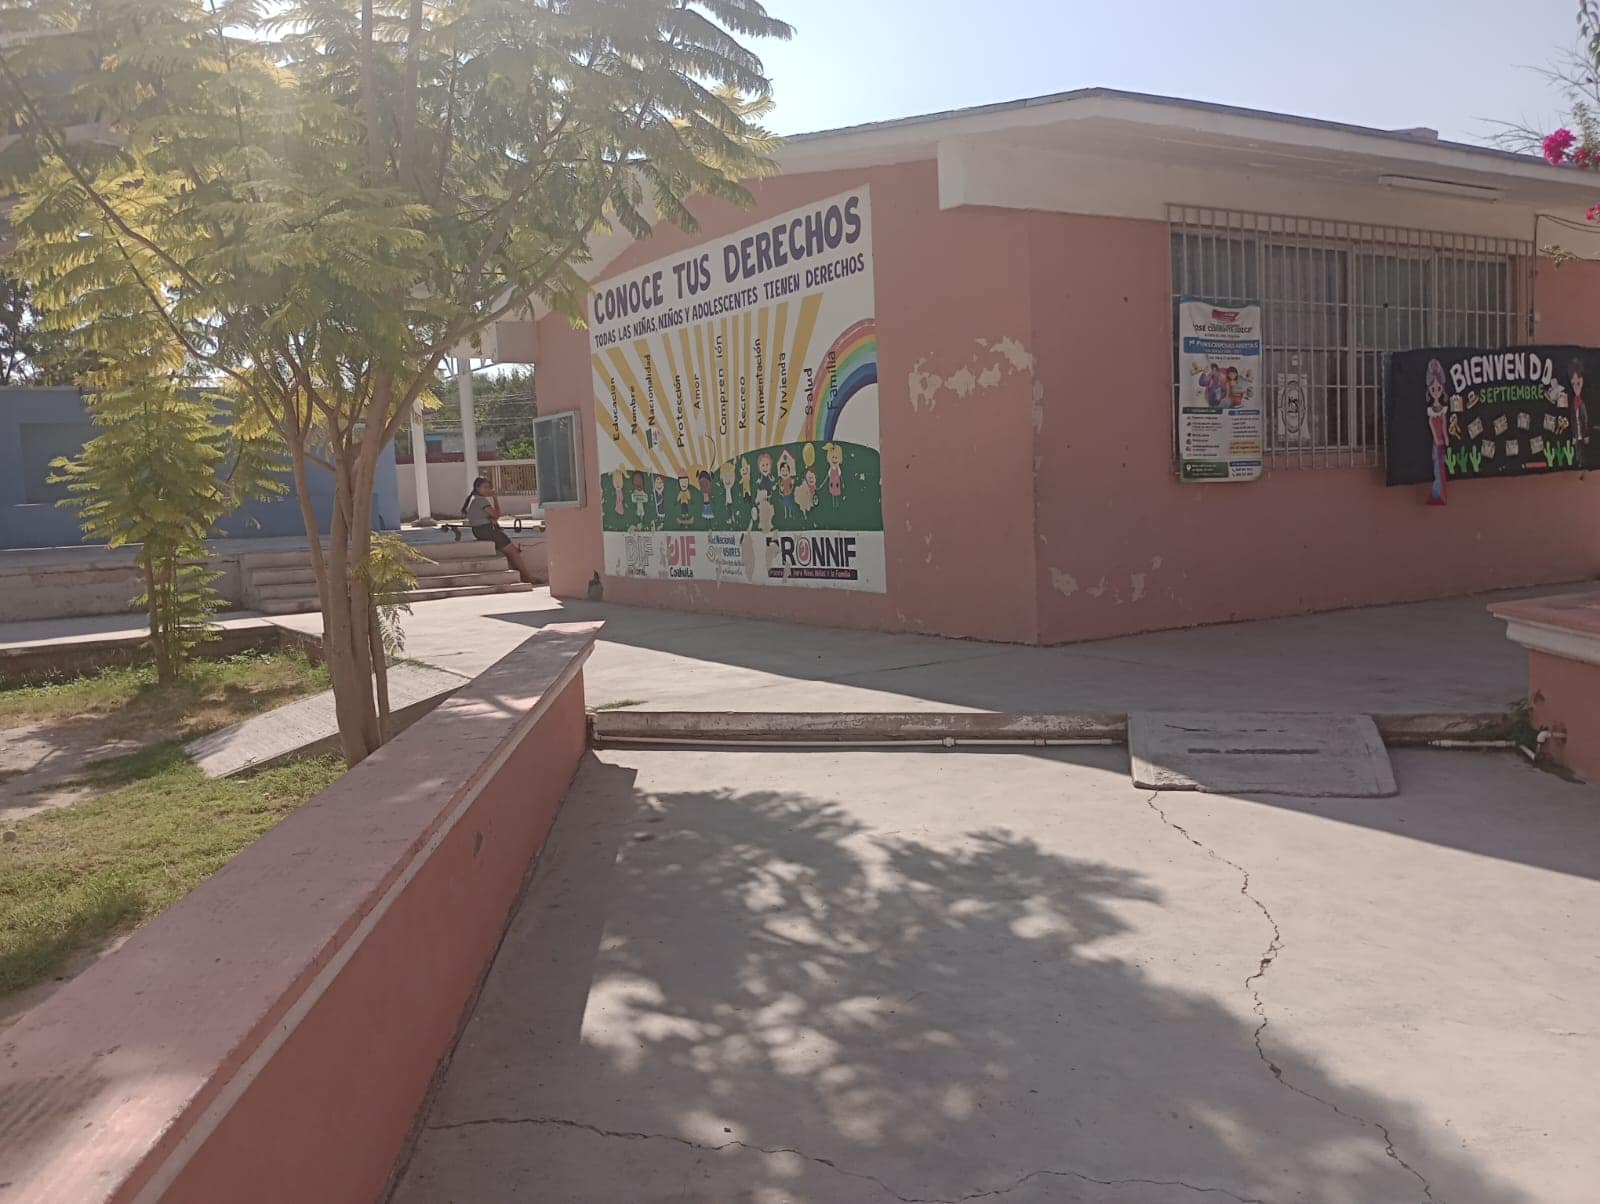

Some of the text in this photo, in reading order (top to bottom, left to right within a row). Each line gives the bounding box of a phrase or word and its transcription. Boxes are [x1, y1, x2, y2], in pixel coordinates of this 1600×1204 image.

[594, 196, 862, 324] CONOCE TUS DERECHOS
[595, 333, 617, 348] TODAS
[618, 327, 632, 342] LAS
[658, 308, 683, 332] NIÑOS
[684, 307, 691, 323] Y
[691, 287, 758, 321] ADOLESCENTES
[763, 273, 800, 300] TIENEN
[805, 253, 865, 289] DERECHOS
[644, 354, 656, 426] Nacionalidad
[693, 373, 701, 410] Amor
[739, 376, 747, 430] Recreo
[752, 338, 766, 426] Alimentación
[778, 352, 788, 419] Vivienda
[803, 367, 813, 416] Salud
[826, 351, 839, 410] Familia
[1480, 383, 1545, 404] SEPTIEMBRE
